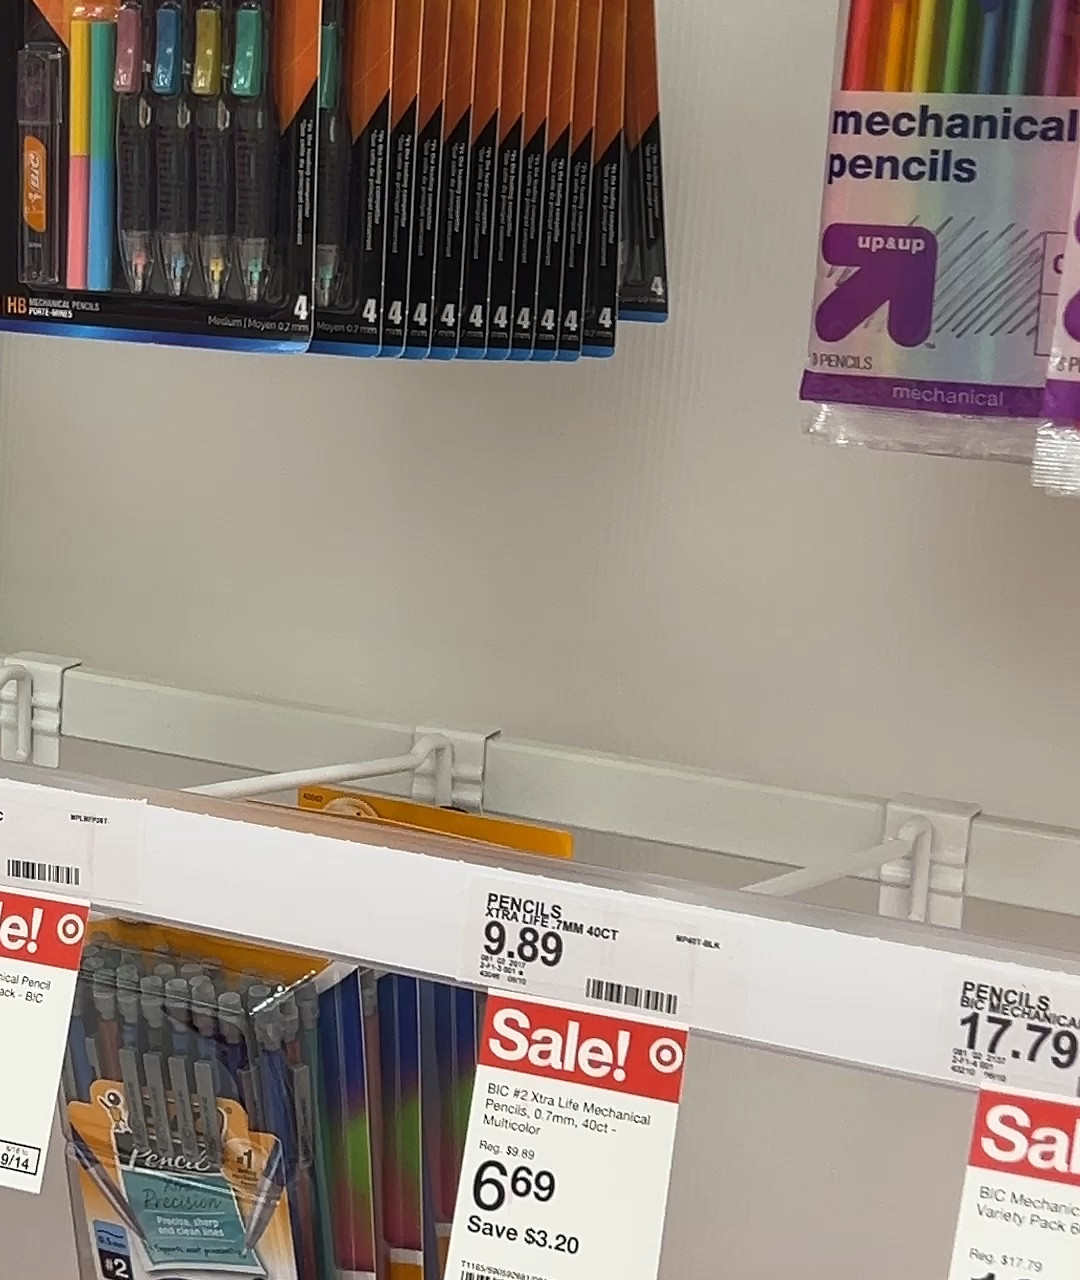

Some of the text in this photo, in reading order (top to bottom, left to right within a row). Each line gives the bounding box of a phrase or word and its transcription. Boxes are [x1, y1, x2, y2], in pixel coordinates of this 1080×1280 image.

[832, 105, 1078, 143] mechanical
[827, 149, 977, 184] pencils
[857, 235, 925, 253] up&up
[8, 296, 26, 313] HB
[294, 296, 308, 319] 4
[892, 384, 1004, 407] mechanical
[488, 893, 562, 919] PENCILS
[485, 906, 619, 941] XTRA LIFE 40CT
[483, 920, 563, 967] 9.89
[21, 976, 51, 990] Pencil
[960, 996, 984, 1011] BIC
[962, 981, 1050, 1011] PENCILS
[488, 1008, 631, 1082] Sale!
[960, 1011, 1078, 1069] 17.79
[512, 1088, 652, 1125] #2 Xtra Life Mechanical
[482, 1114, 541, 1135] Multicolor
[581, 1118, 608, 1133] 40ct
[1, 1153, 30, 1170] 9/14
[506, 1145, 535, 1160] $9.89
[143, 1189, 222, 1209] Precision
[976, 1204, 1065, 1233] Variety Pack
[176, 1227, 202, 1236] clean
[467, 1216, 579, 1254] Save $3.20
